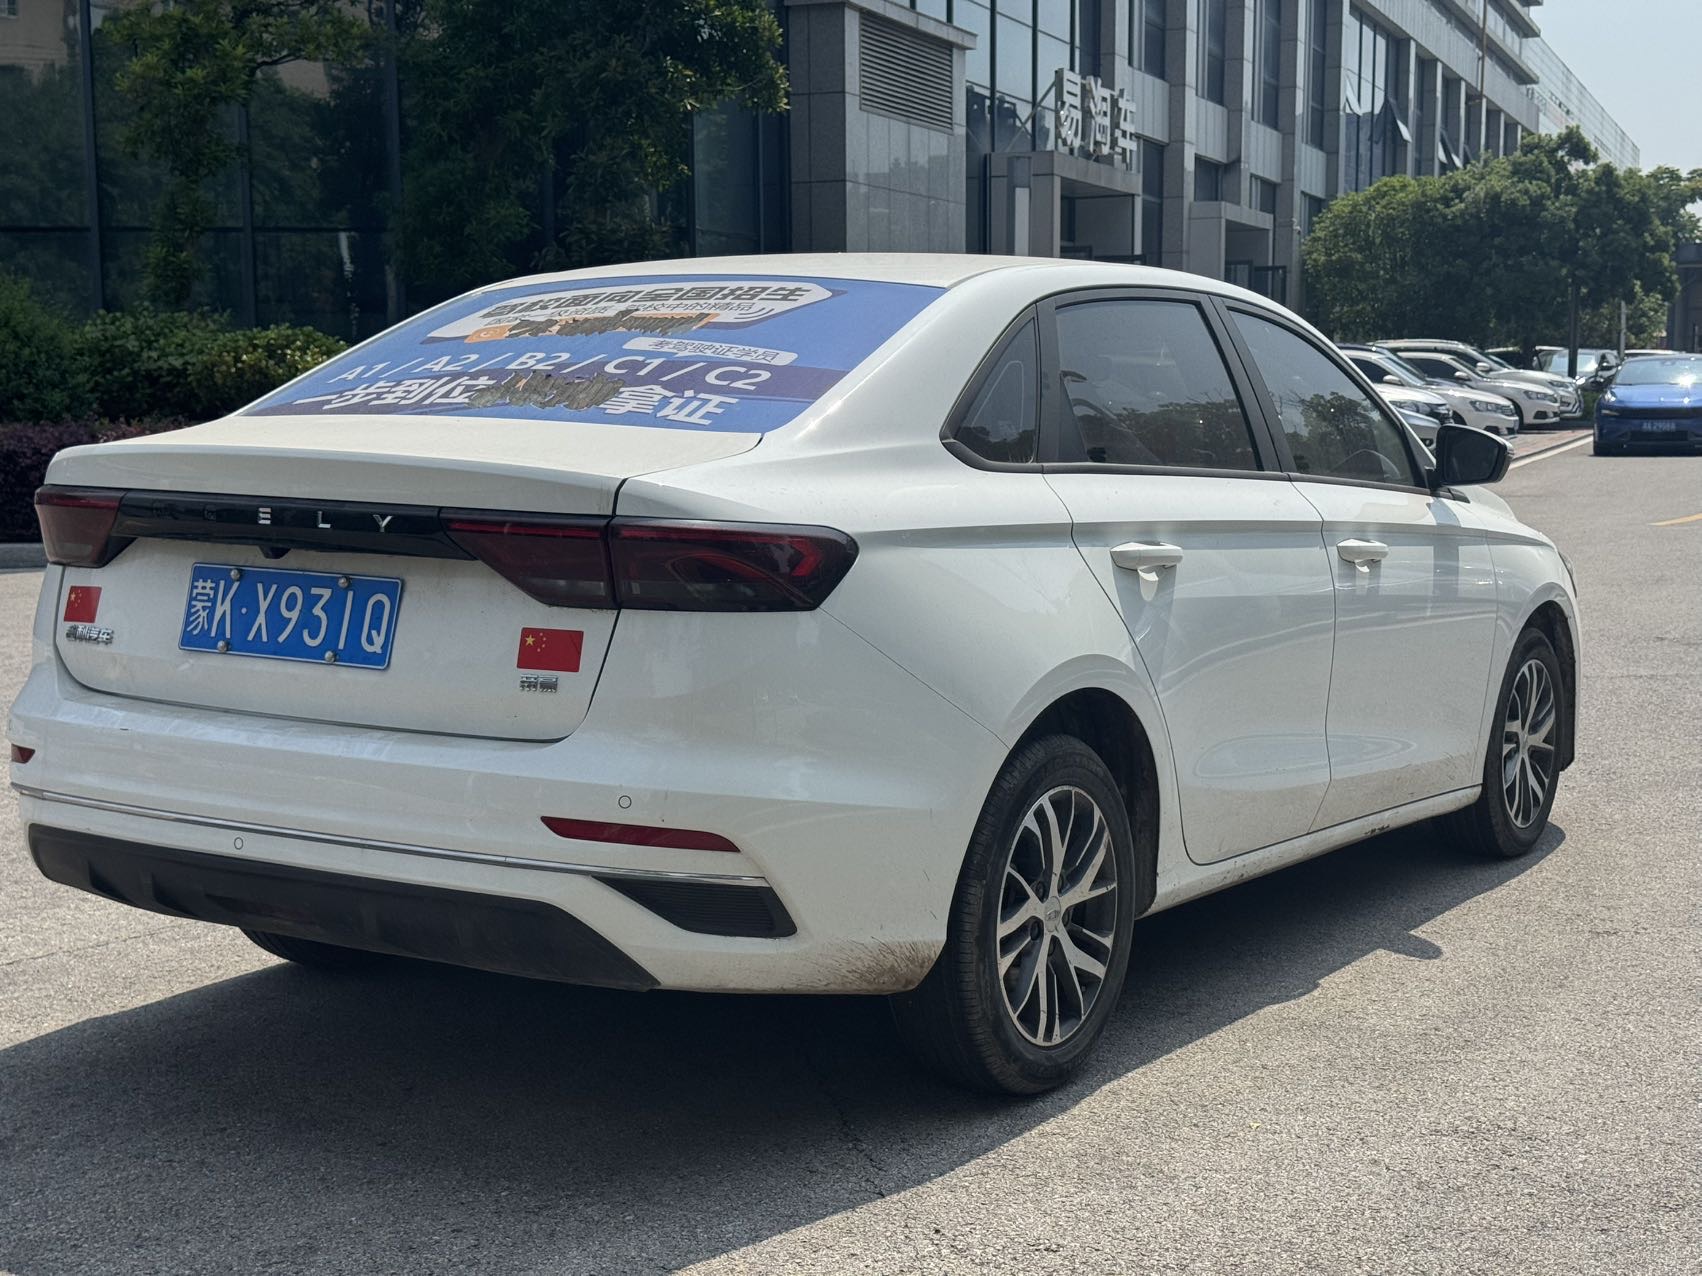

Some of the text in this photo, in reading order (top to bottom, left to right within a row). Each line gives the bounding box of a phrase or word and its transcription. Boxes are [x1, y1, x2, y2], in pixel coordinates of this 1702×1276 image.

[480, 286, 811, 318] 驾校面向全国招生
[327, 361, 391, 383] A1
[410, 353, 480, 373] A2
[505, 352, 571, 370] B2
[604, 355, 667, 376] C1
[705, 366, 772, 391] C2
[292, 376, 497, 410] 一步到位
[600, 384, 740, 426] 拿证
[186, 578, 391, 654] 蒙K·X931Q
